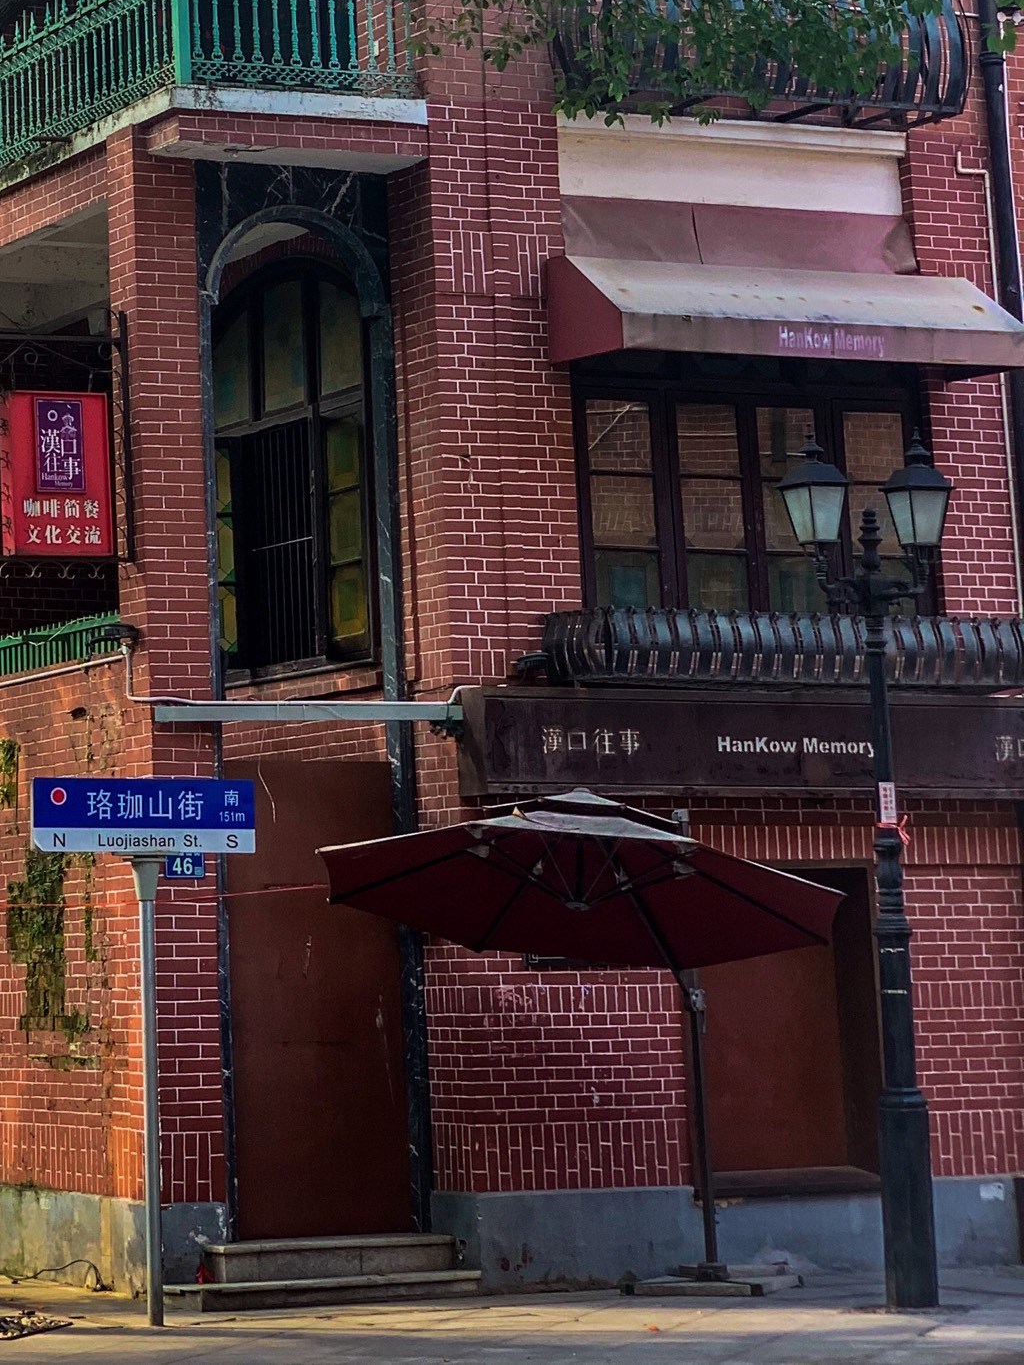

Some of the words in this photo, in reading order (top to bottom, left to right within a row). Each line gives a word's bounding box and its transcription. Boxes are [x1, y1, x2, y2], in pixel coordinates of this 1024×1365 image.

[779, 325, 832, 350] HanKow
[835, 328, 884, 358] Memory
[40, 428, 77, 457] 漢口
[44, 453, 81, 480] 往事
[23, 498, 100, 519] 咖啡简餐
[26, 524, 102, 545] 文化交流
[542, 728, 640, 756] 漢口往事
[717, 736, 797, 754] HanKow
[802, 737, 875, 758] Memory
[86, 788, 204, 821] 珞珈山街
[224, 789, 240, 807] 南
[219, 810, 246, 822] 151m
[53, 833, 66, 847] N
[98, 834, 175, 849] Luojiashan
[183, 834, 203, 847] St.
[226, 834, 239, 848] S
[172, 857, 193, 875] 46
